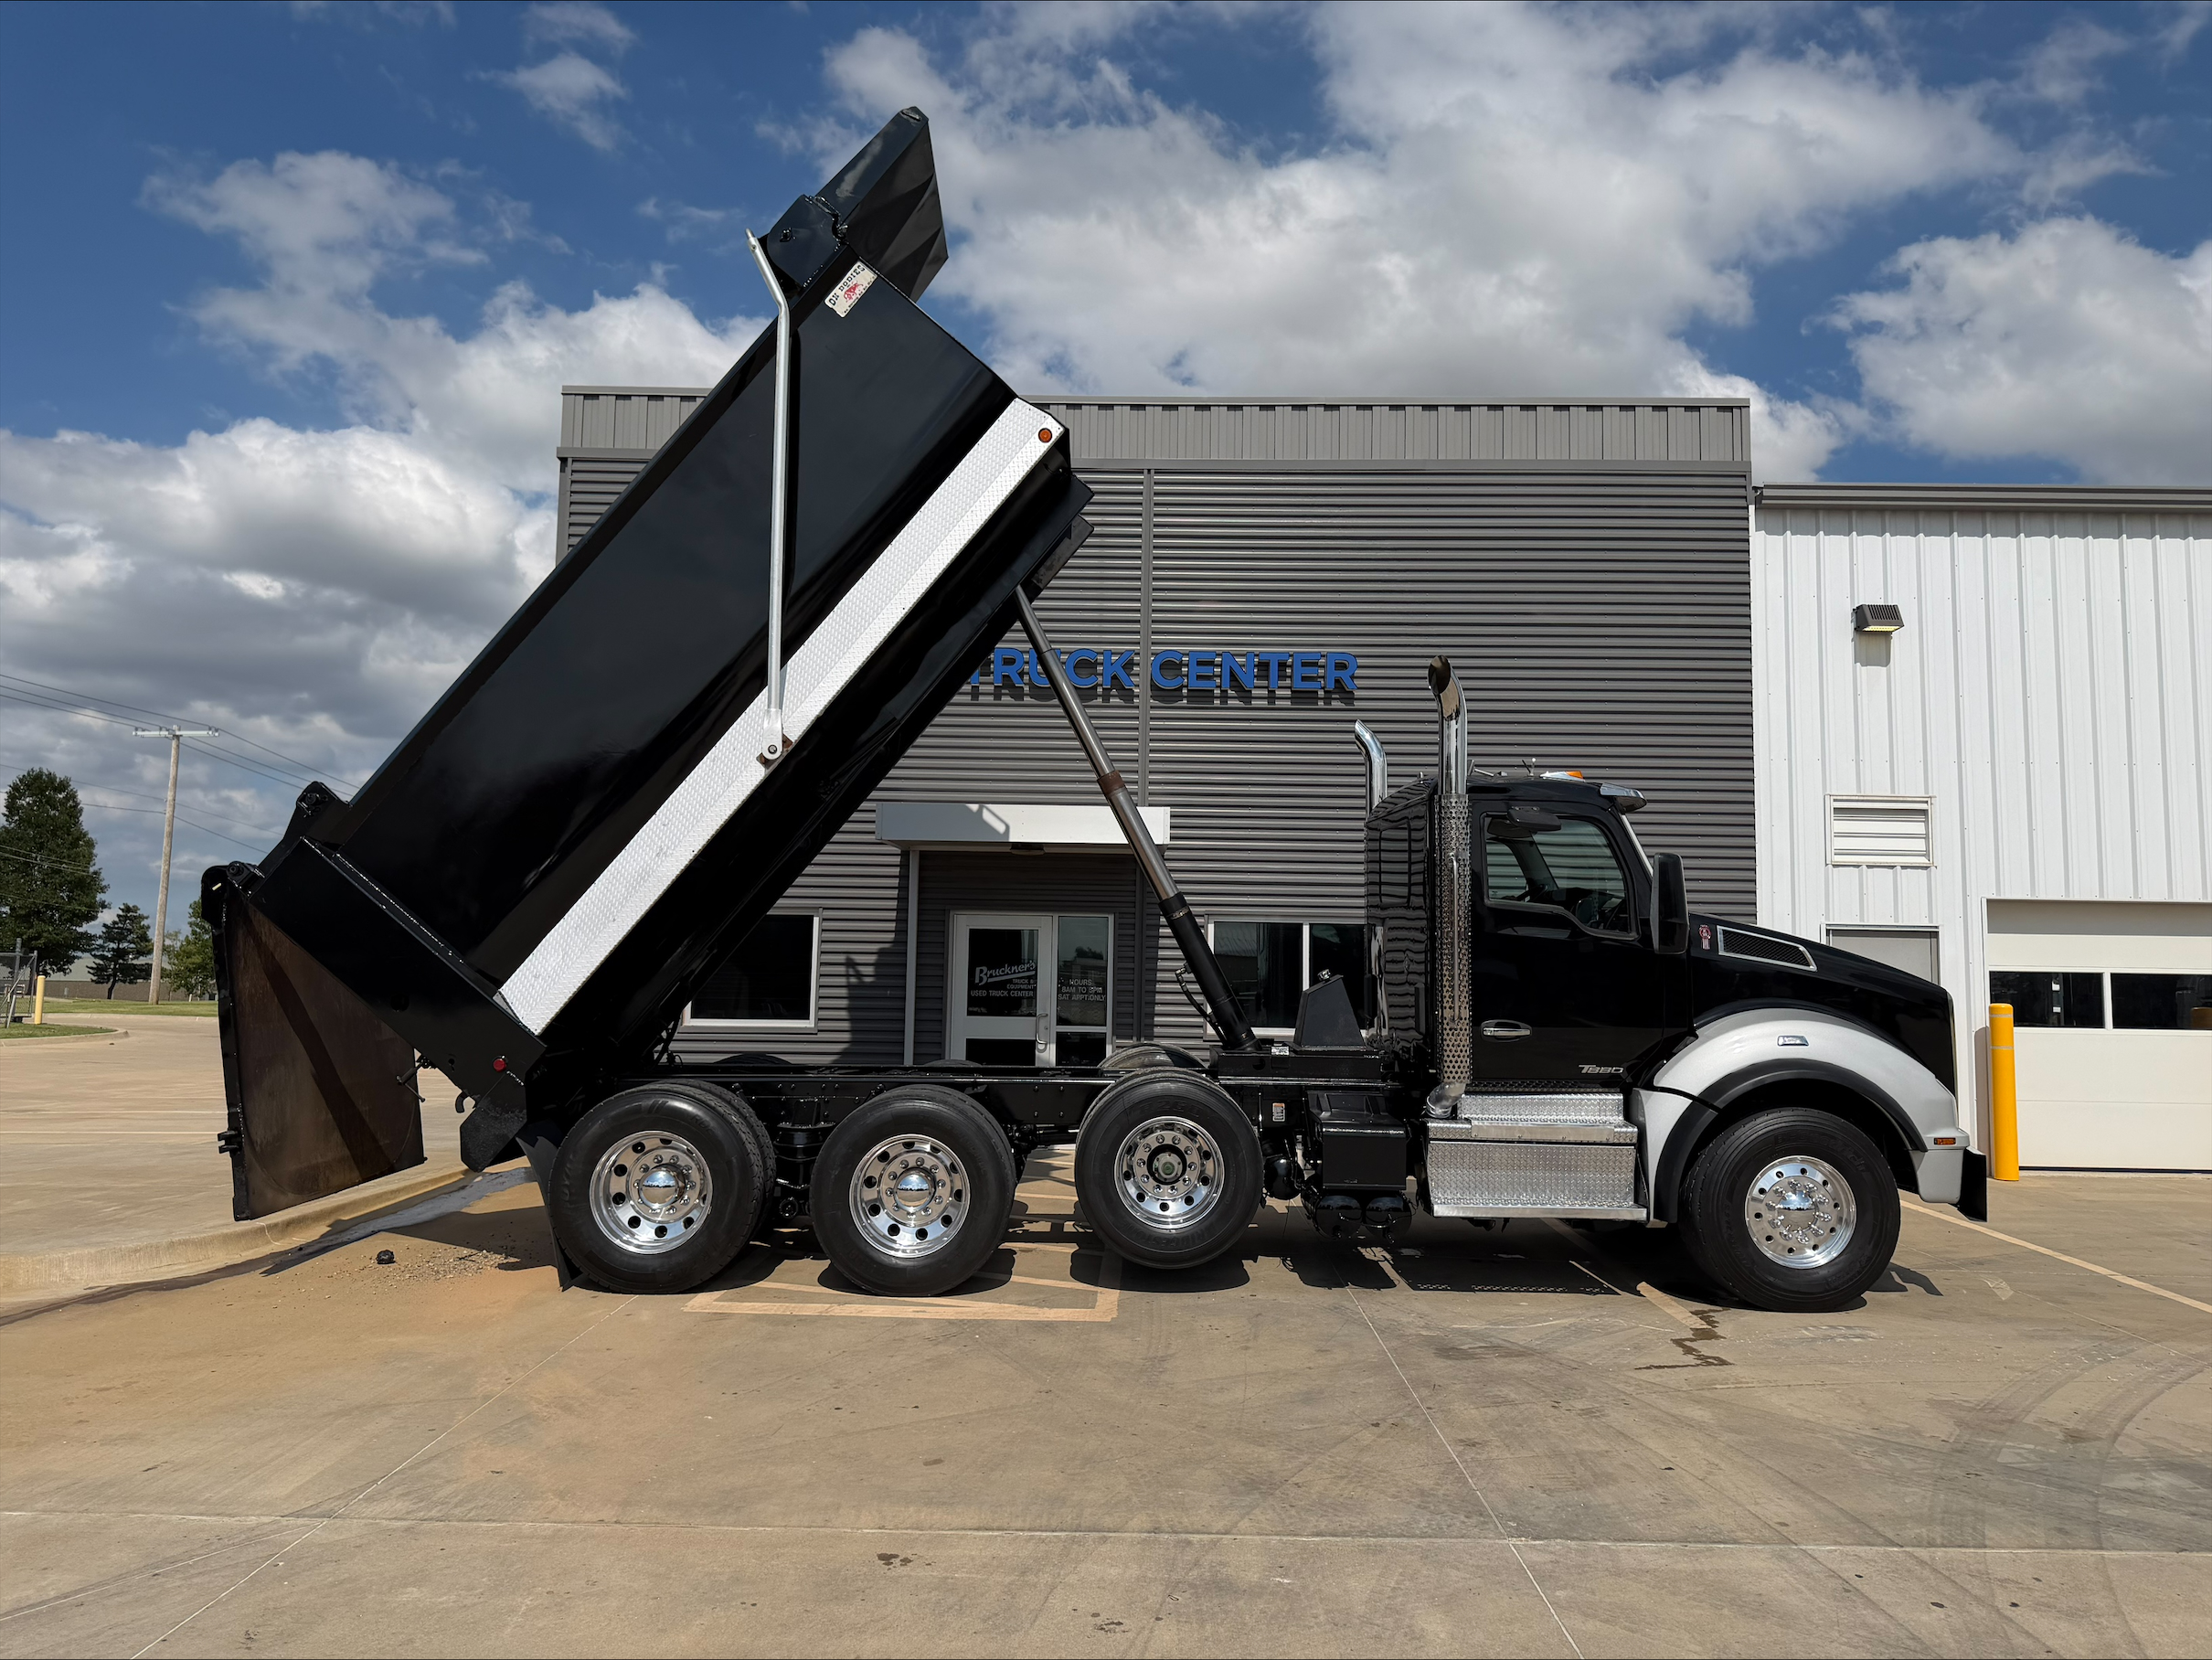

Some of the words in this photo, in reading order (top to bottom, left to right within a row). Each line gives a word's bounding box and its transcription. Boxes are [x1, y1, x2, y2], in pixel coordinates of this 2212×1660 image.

[838, 264, 866, 292] BODIES
[970, 647, 1135, 688] RUCK
[1151, 650, 1358, 691] CENTER
[974, 960, 1036, 986] Bruckner's
[1069, 978, 1092, 986] HOURS
[971, 989, 987, 997] USED
[989, 989, 1009, 997] TRUCK
[1010, 989, 1034, 997] CENTER
[1061, 985, 1076, 994] 8AM
[1057, 993, 1070, 1001] SAT
[1578, 1064, 1624, 1074] T880
